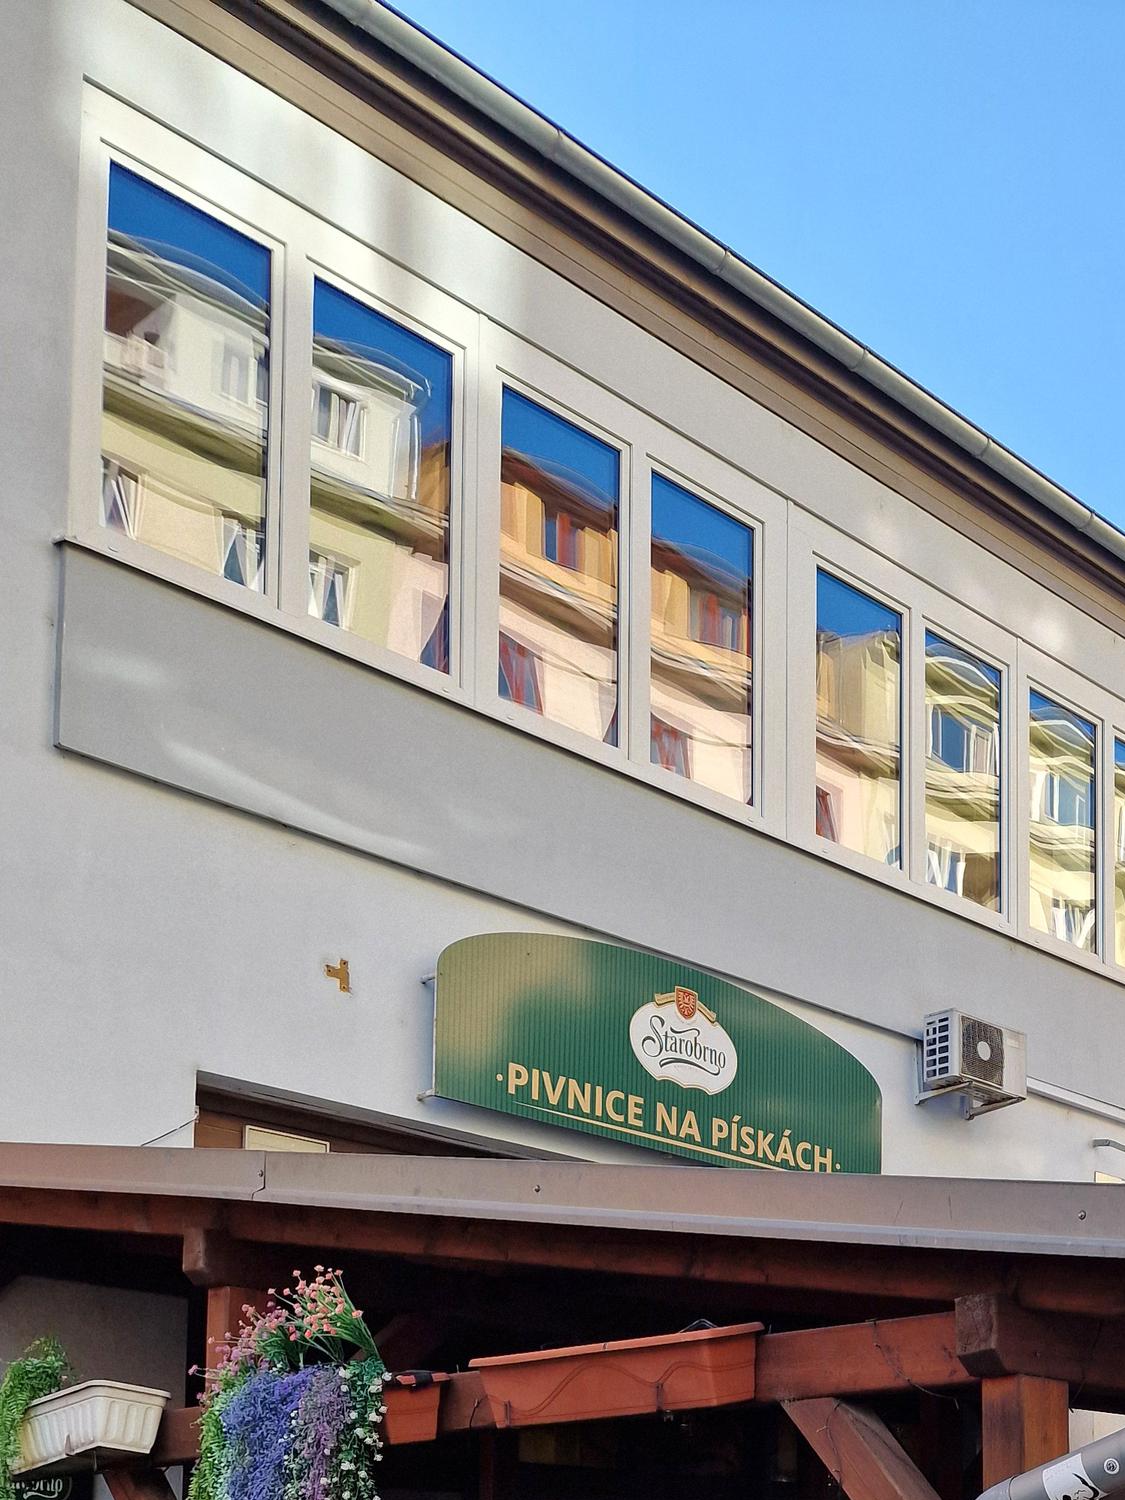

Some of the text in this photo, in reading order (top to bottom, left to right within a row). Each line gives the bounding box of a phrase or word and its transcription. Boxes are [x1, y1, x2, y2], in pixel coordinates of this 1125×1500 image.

[641, 1014, 727, 1076] Starobrno
[507, 1061, 833, 1172] PIVNICE NA PÍSKÁCH
